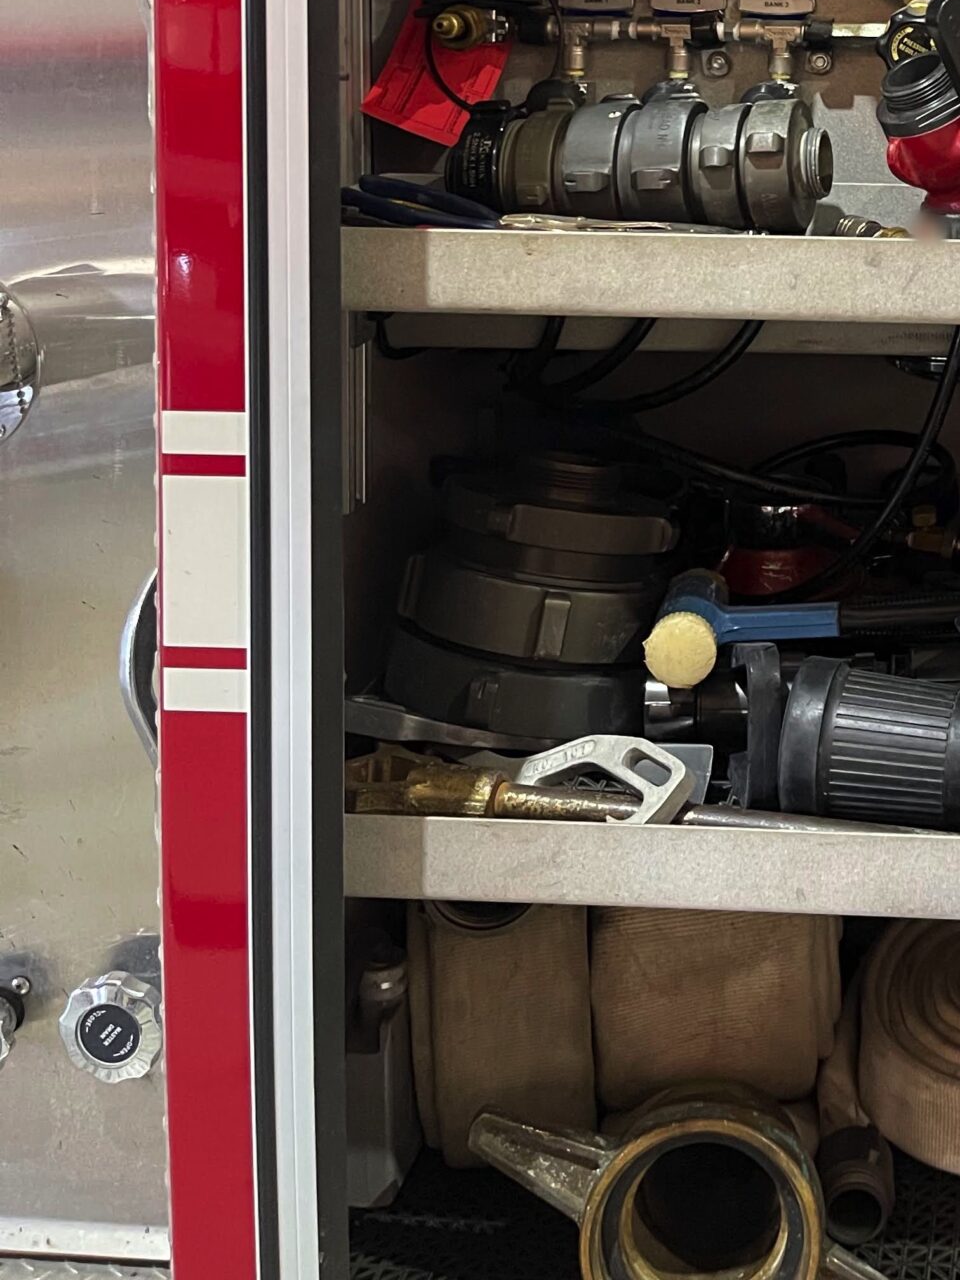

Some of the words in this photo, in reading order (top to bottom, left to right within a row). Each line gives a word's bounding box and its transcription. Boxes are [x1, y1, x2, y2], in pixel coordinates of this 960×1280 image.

[85, 1010, 101, 1027] CLOSE
[102, 1026, 122, 1046] MASTER
[119, 1041, 133, 1055] OPEN
